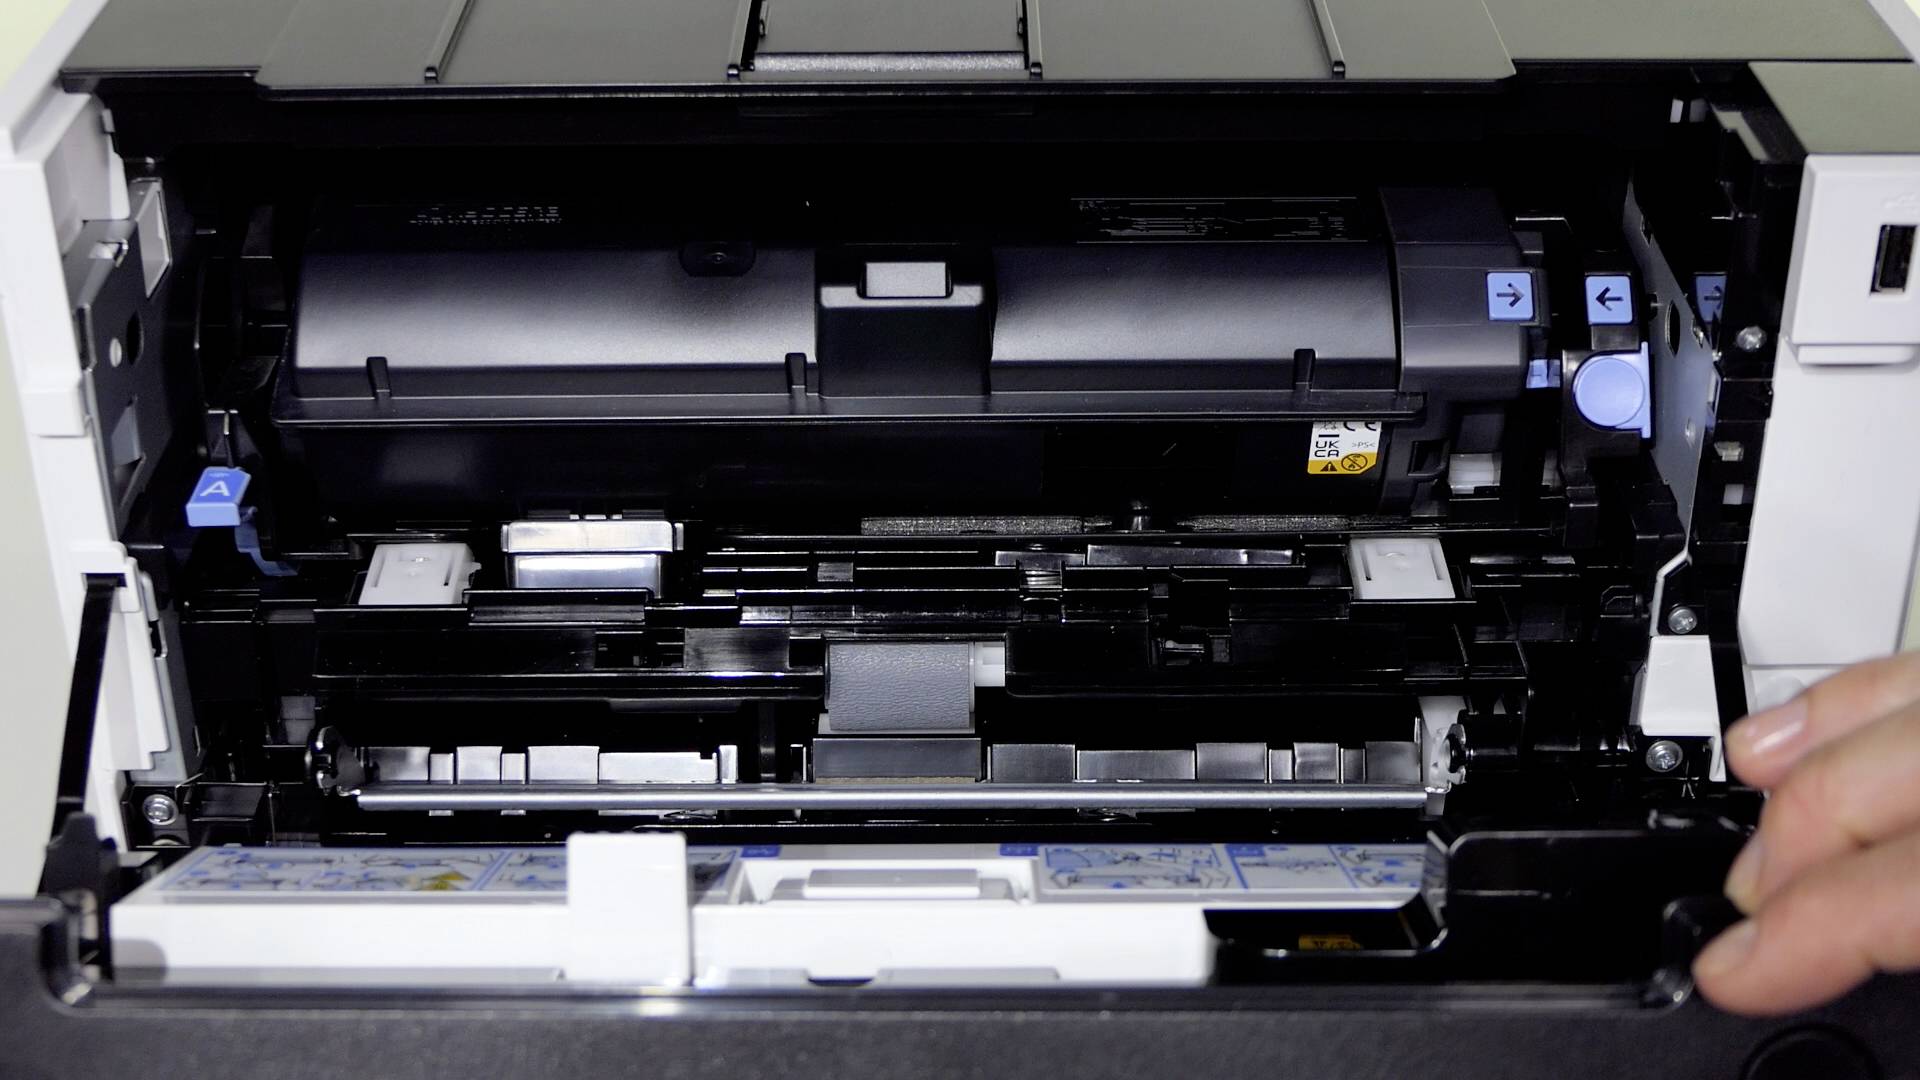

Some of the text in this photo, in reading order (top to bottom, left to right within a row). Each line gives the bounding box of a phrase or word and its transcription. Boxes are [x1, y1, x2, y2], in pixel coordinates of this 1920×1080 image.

[1315, 440, 1339, 449] UK
[1314, 449, 1340, 458] CA
[199, 480, 231, 497] A
